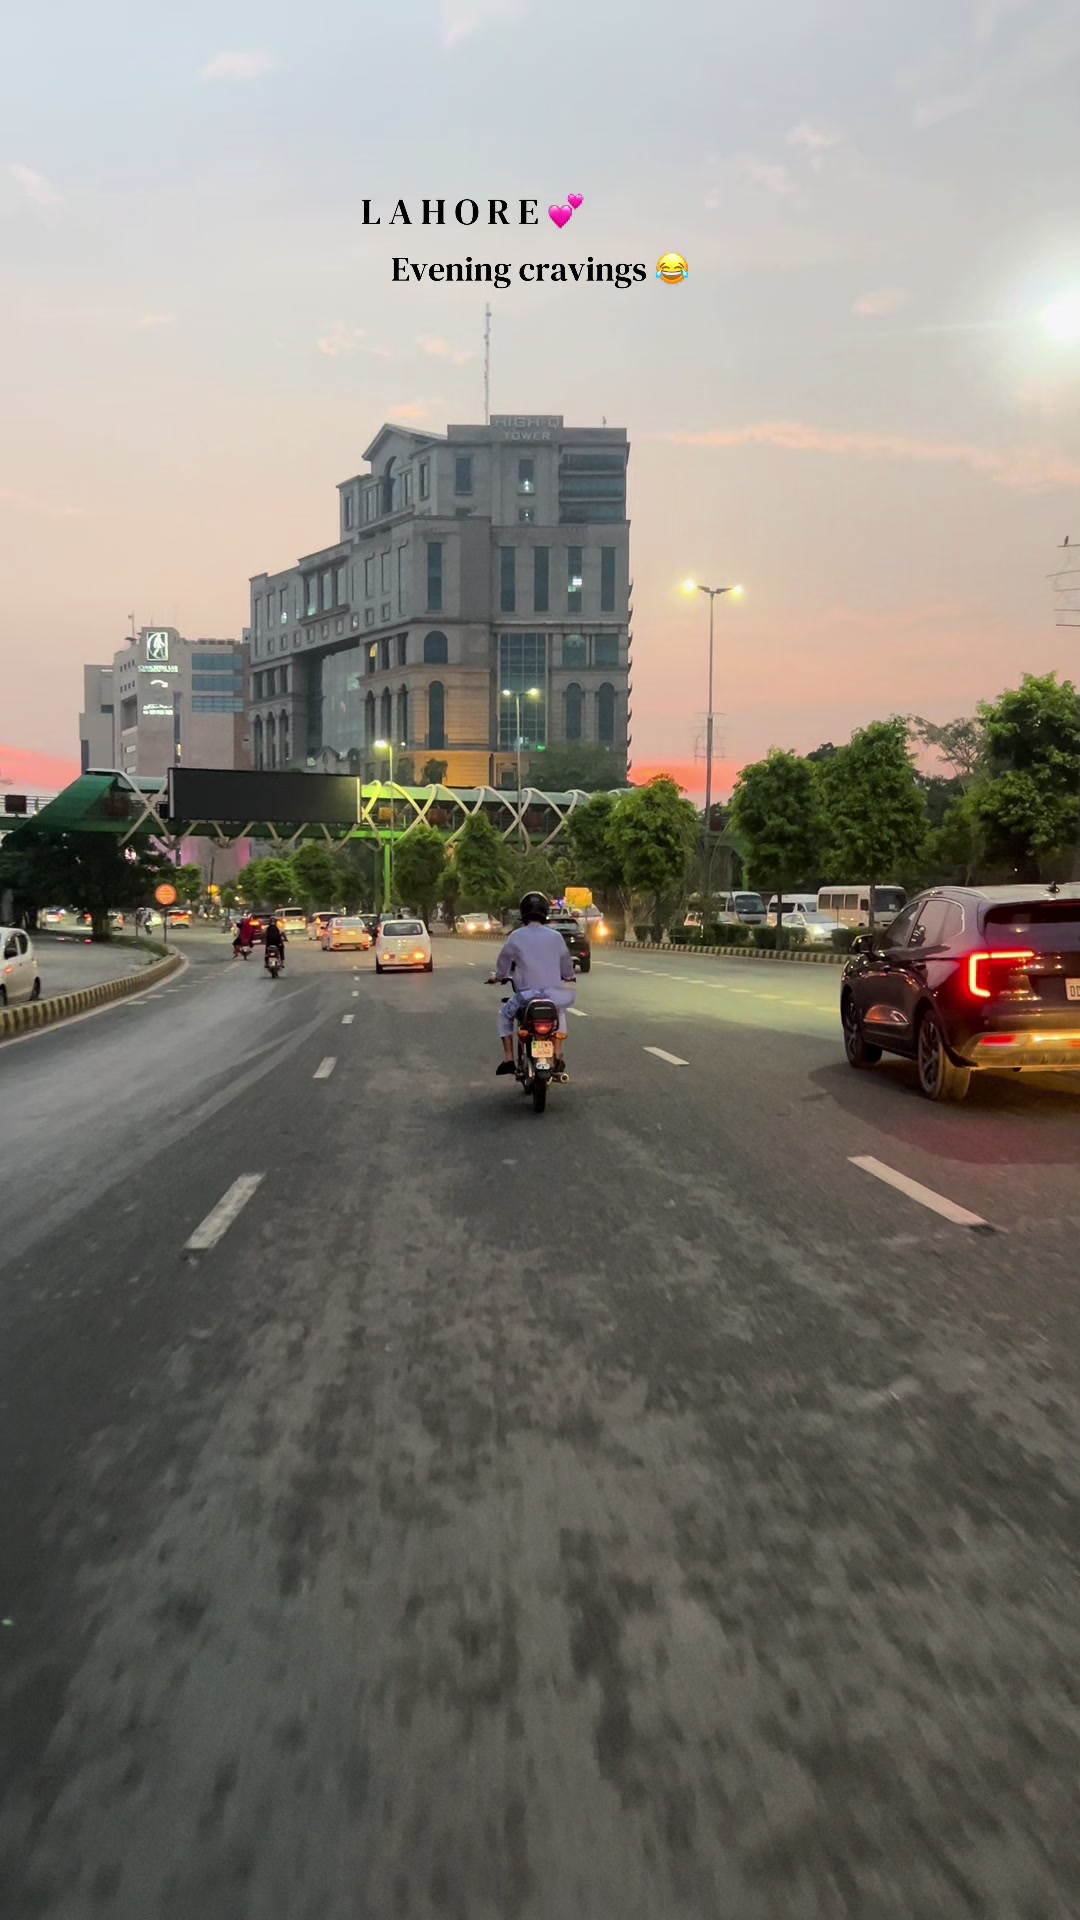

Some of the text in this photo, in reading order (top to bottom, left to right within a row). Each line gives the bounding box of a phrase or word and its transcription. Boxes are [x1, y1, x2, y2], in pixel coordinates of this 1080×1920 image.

[495, 416, 560, 430] HIGH Q
[504, 430, 551, 441] TOWER
